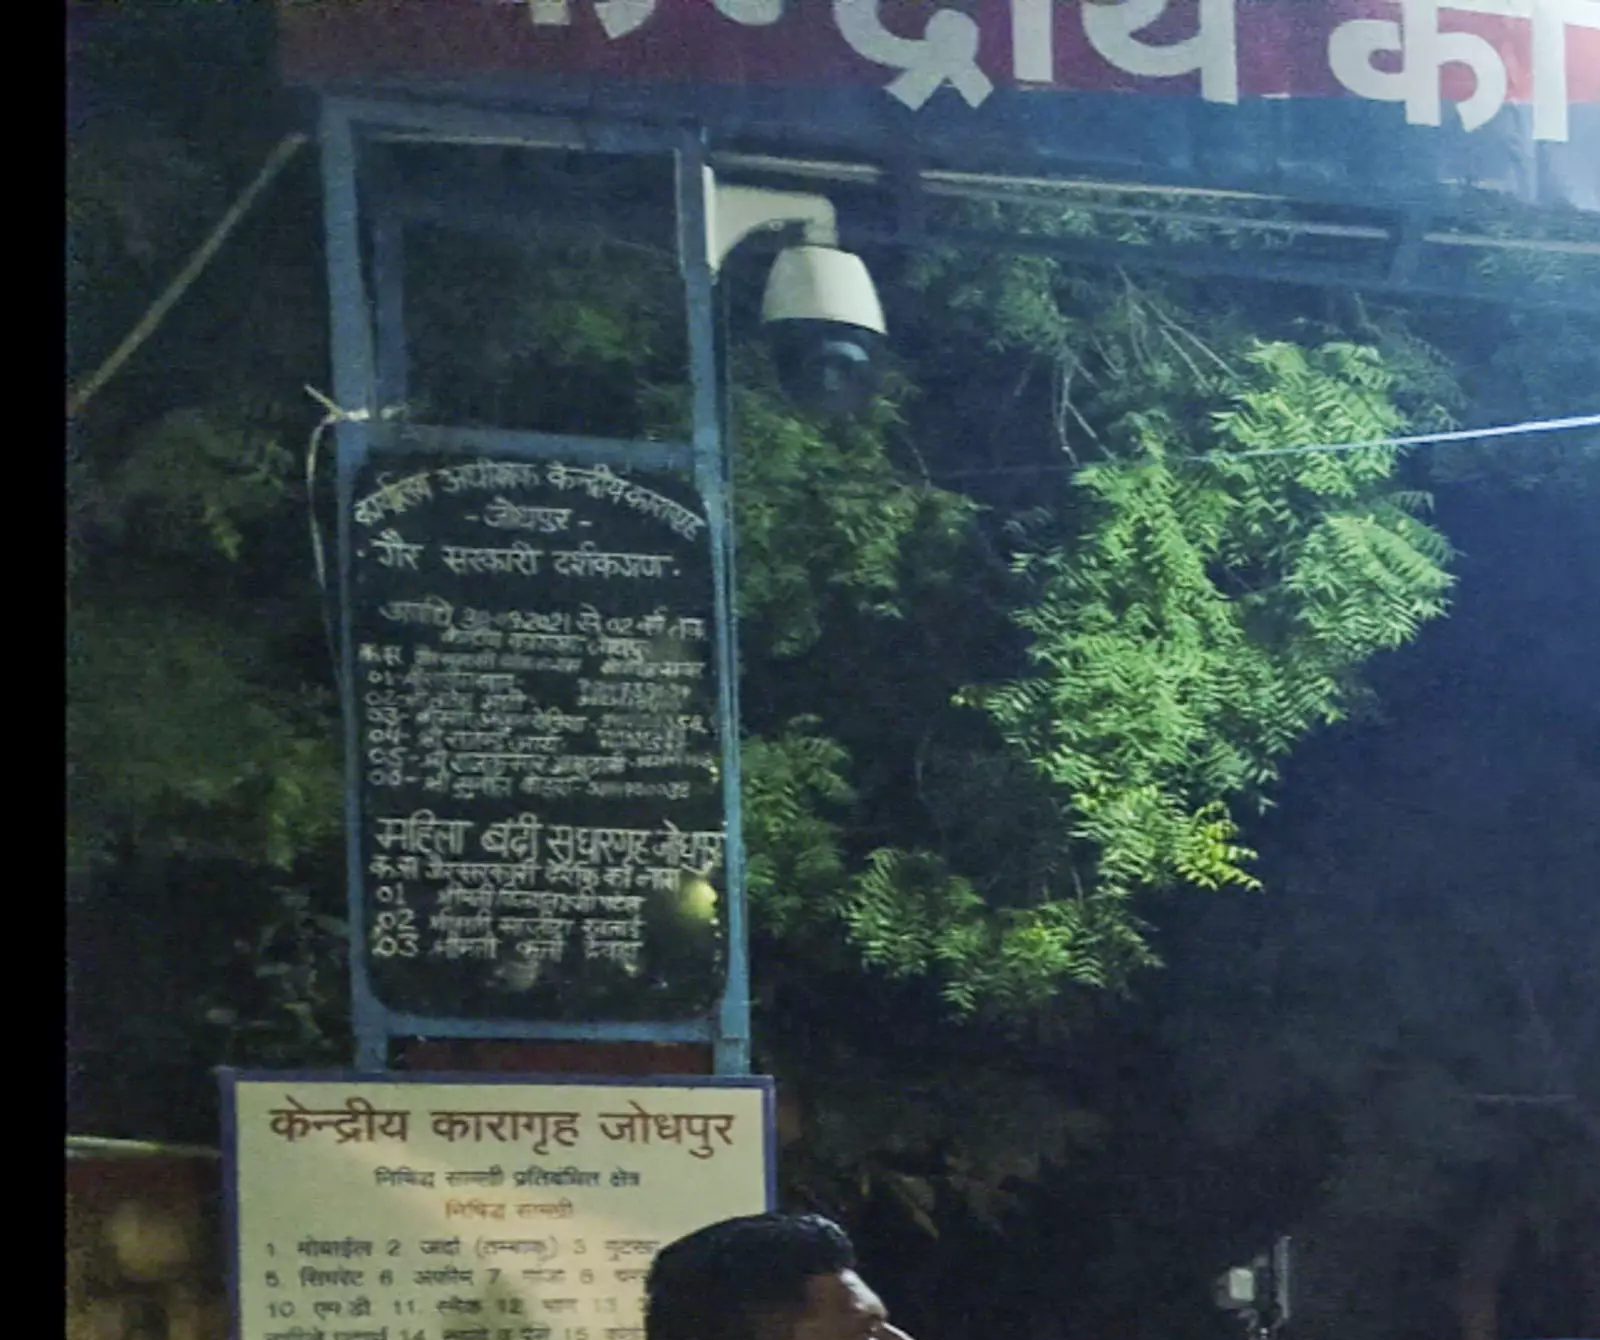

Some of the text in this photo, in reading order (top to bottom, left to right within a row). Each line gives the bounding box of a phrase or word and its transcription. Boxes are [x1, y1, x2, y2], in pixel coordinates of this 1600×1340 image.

[440, 541, 545, 576] सरकारी
[373, 808, 472, 856] महिला
[475, 811, 540, 859] बंदी
[268, 1093, 736, 1160] केन्द्रीय कारागृह जोधपुर
